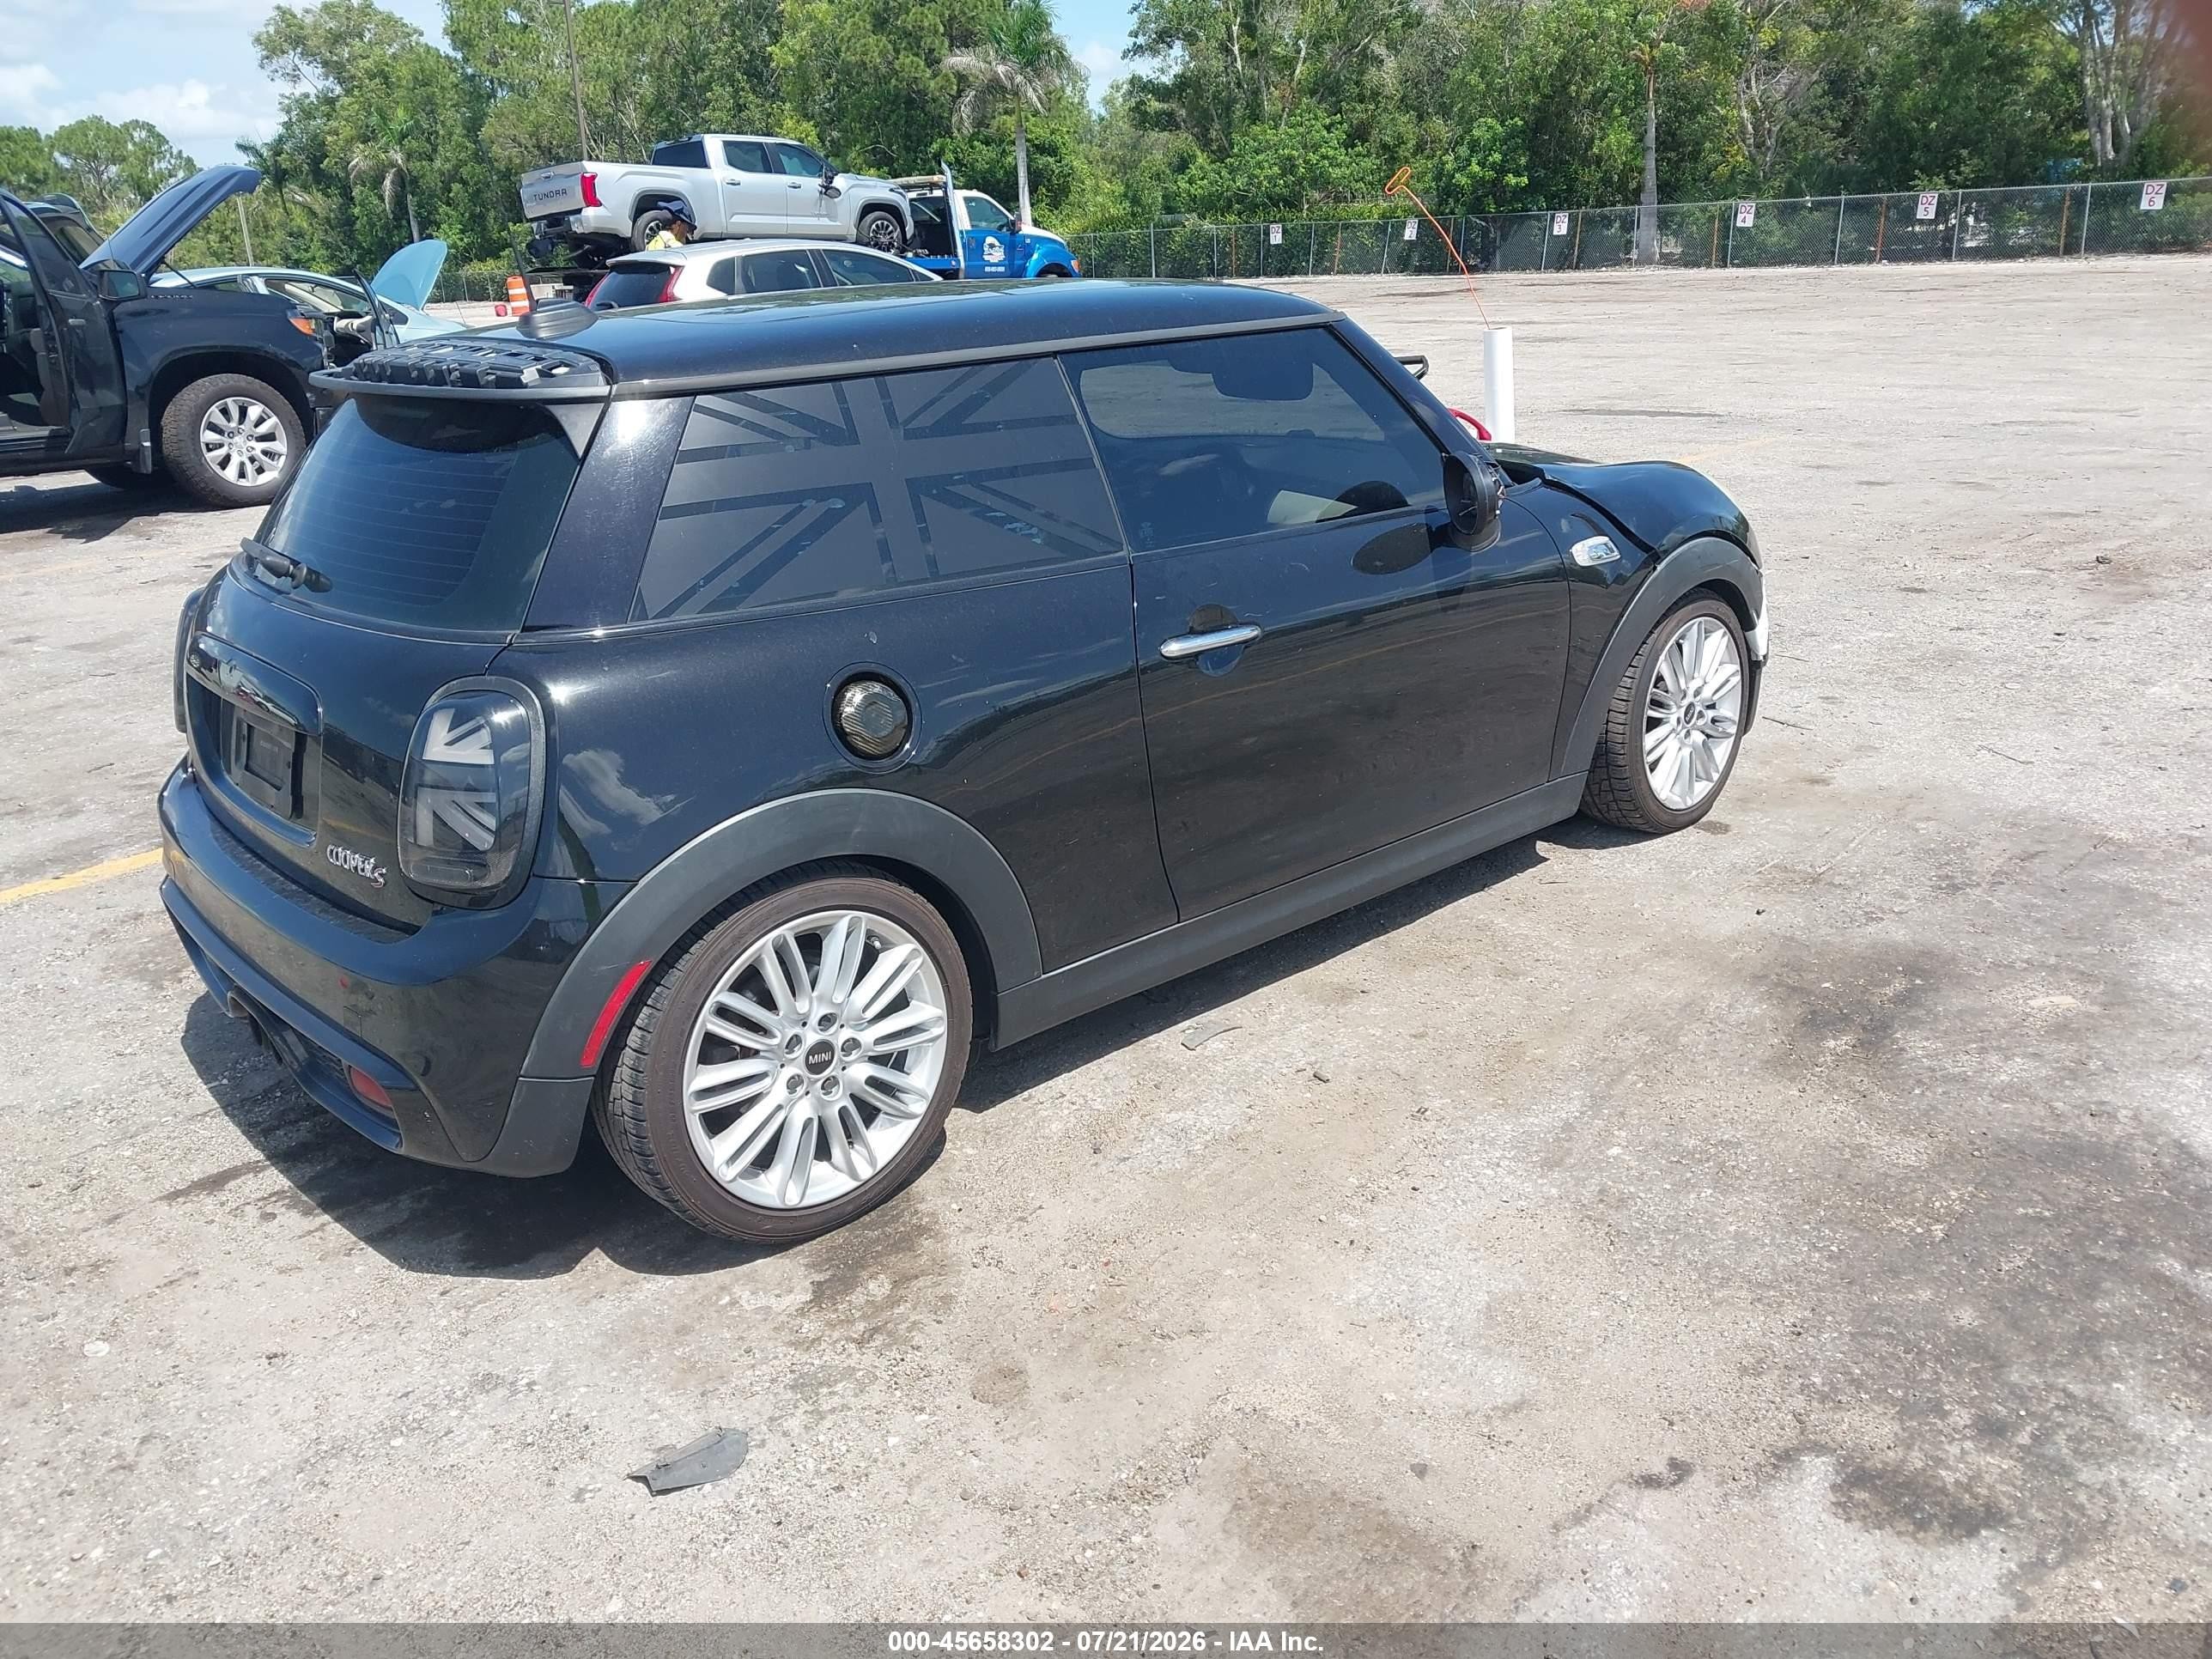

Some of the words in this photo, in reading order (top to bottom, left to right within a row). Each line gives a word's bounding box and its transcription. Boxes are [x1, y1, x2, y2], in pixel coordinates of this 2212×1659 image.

[533, 188, 568, 201] TUNDRA
[2145, 184, 2165, 195] DZ
[1920, 195, 1936, 206] DZ
[2148, 197, 2156, 207] 6
[1740, 204, 1753, 215] DZ
[1923, 206, 1929, 216] 5
[1556, 215, 1567, 224] DZ
[1741, 215, 1747, 224] 4
[1271, 226, 1280, 234] DZ
[1407, 221, 1417, 229] DZ
[1557, 224, 1562, 234] 3
[326, 844, 376, 879] COOPER
[370, 867, 386, 888] S
[808, 1051, 832, 1065] MINI
